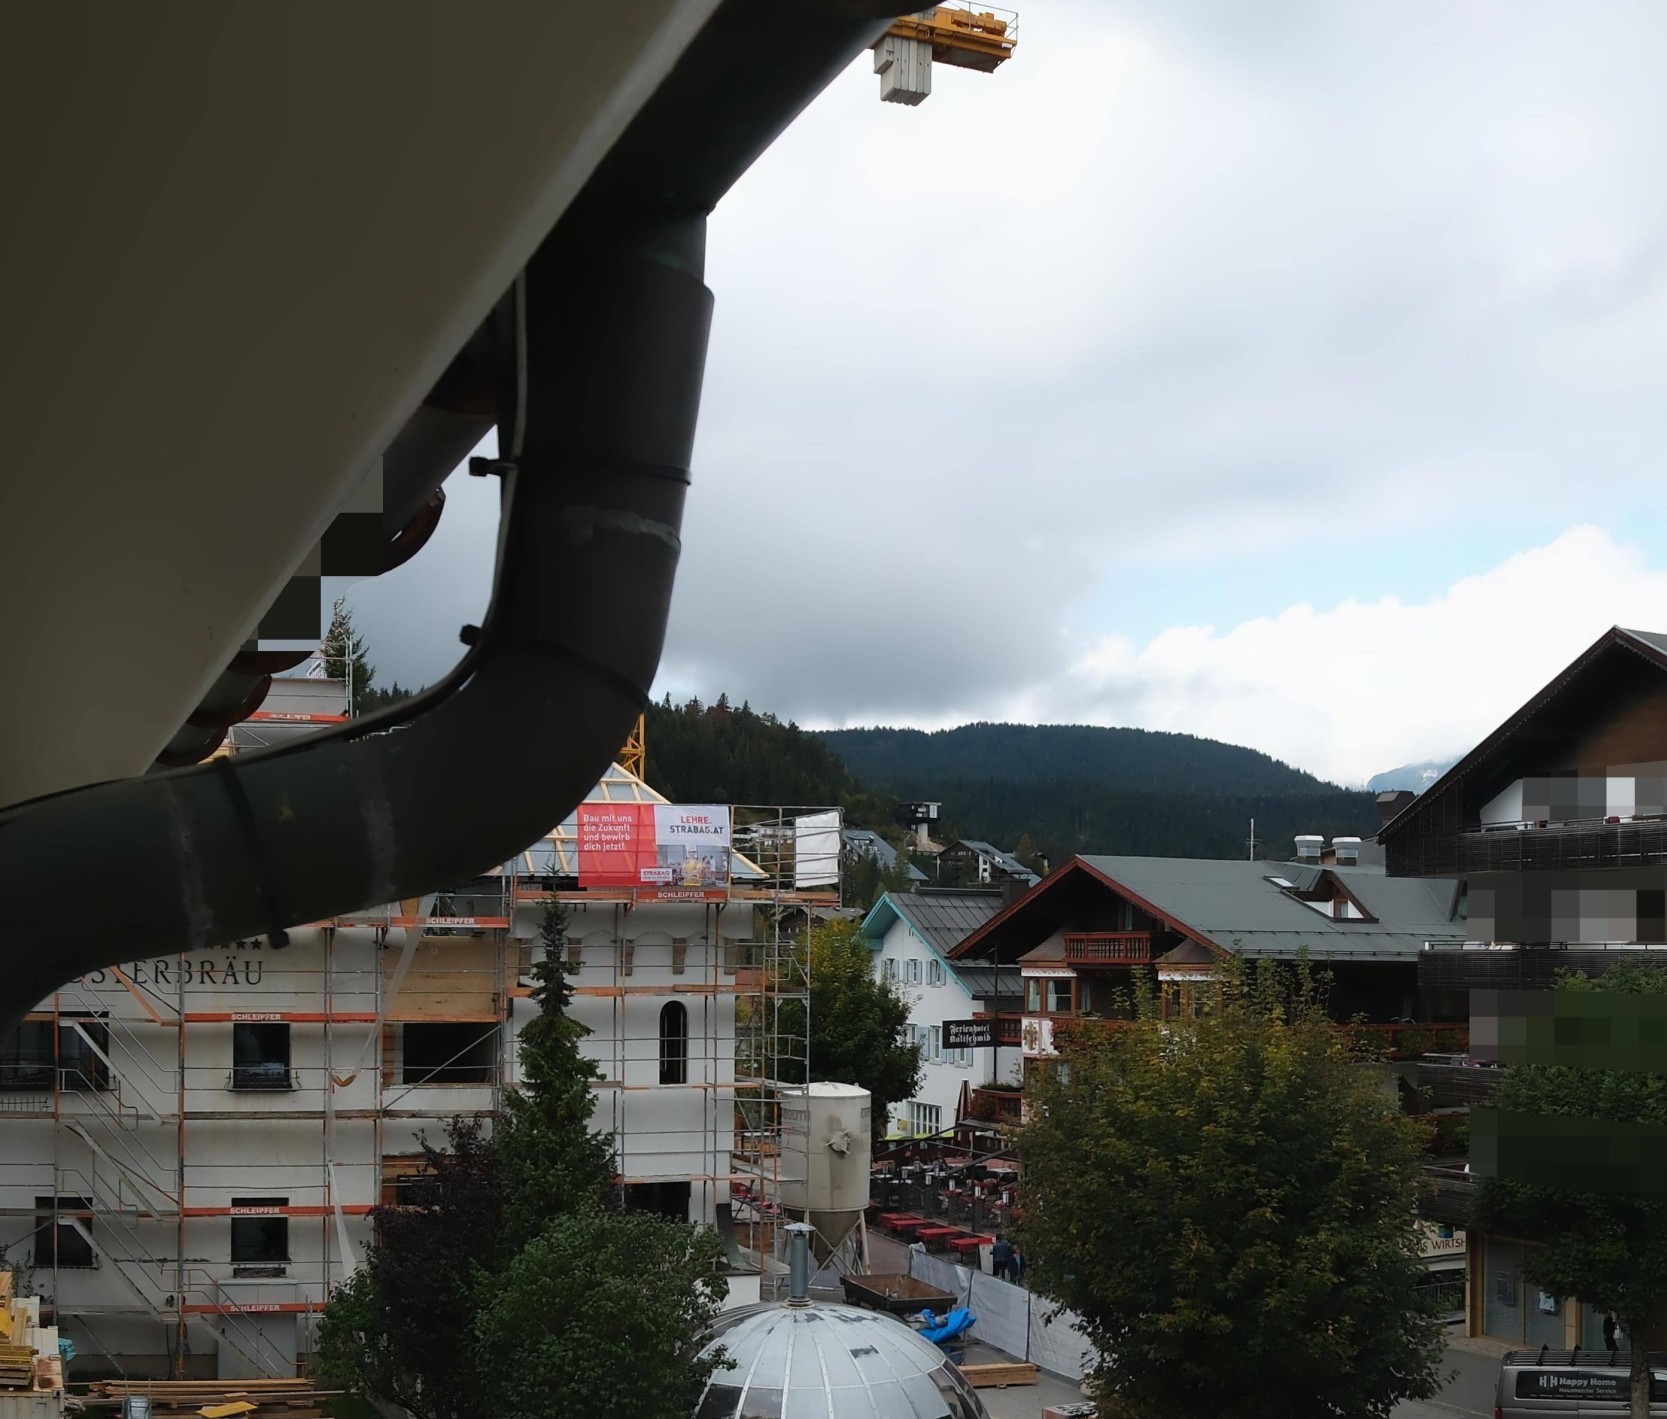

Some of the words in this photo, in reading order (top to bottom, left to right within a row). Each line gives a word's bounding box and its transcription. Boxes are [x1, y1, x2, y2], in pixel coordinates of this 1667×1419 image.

[583, 814, 599, 822] Bau
[602, 814, 616, 822] mit
[681, 816, 711, 824] LEHRE.
[584, 824, 596, 832] die
[598, 824, 630, 832] Zukunft
[670, 825, 724, 834] STRABAG.AT
[584, 833, 599, 841] und
[602, 833, 630, 841] bewirb
[603, 842, 624, 852] jetzt!
[425, 916, 475, 925] SCHLEIPFER
[230, 1013, 281, 1021] SCHLEIPFER
[1559, 1378, 1588, 1386] Happy
[1590, 1378, 1616, 1386] Home
